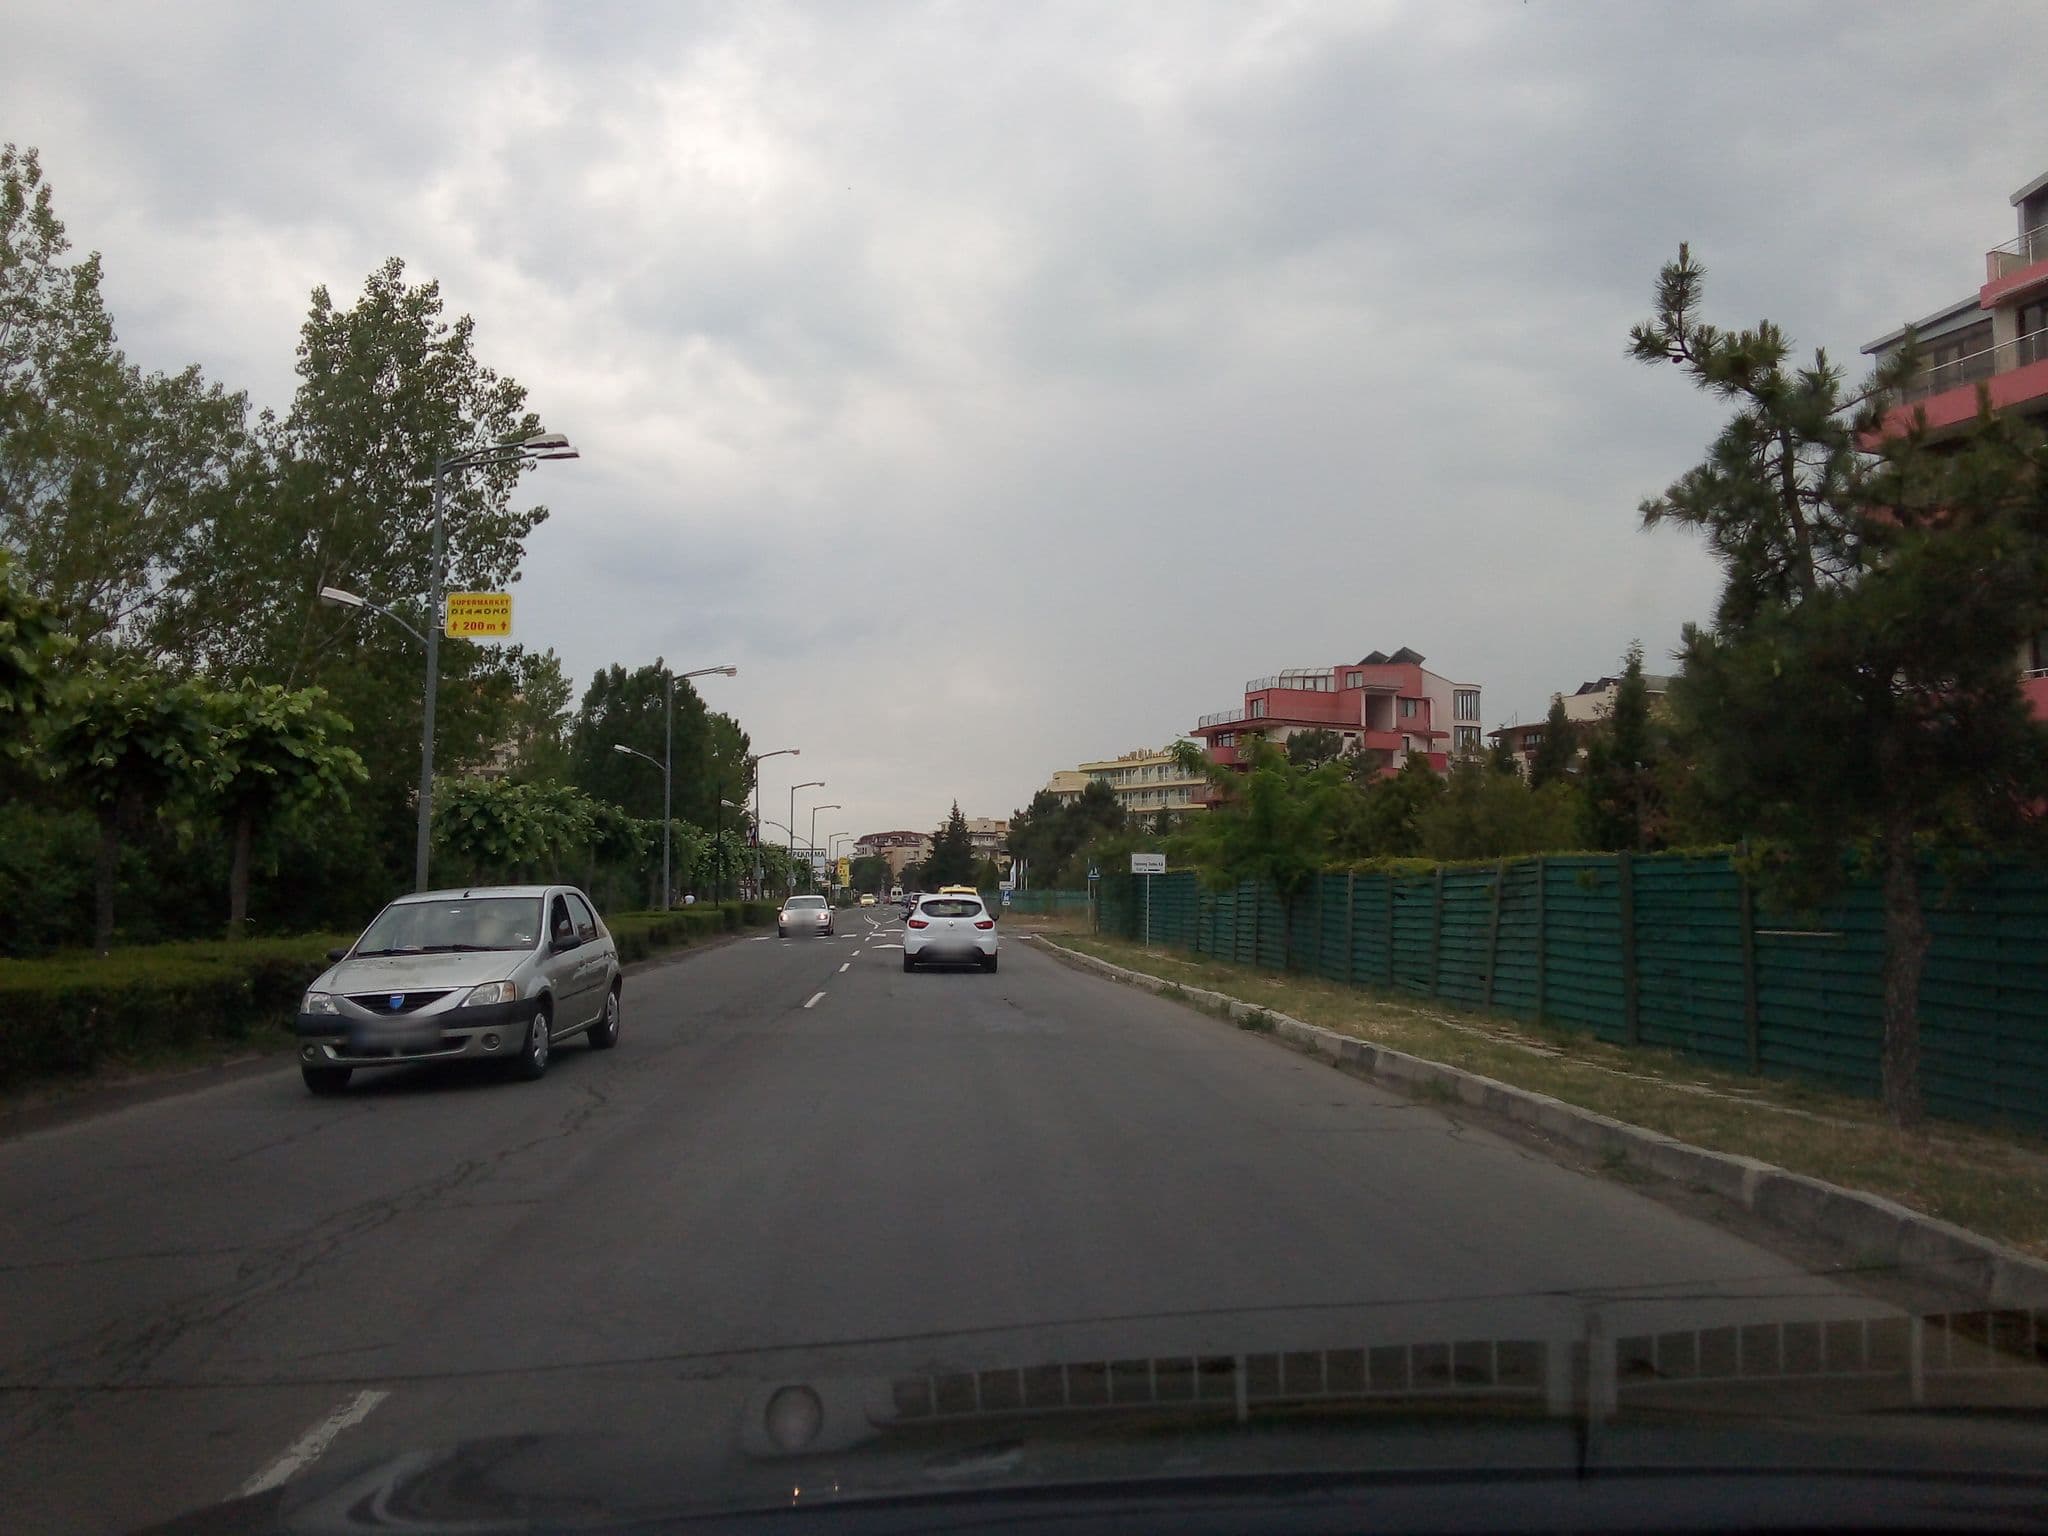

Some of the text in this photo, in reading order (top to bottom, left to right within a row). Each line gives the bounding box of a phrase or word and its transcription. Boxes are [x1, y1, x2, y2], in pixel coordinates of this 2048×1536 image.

[451, 599, 509, 607] SUPERMARKET
[463, 621, 496, 631] 200 m
